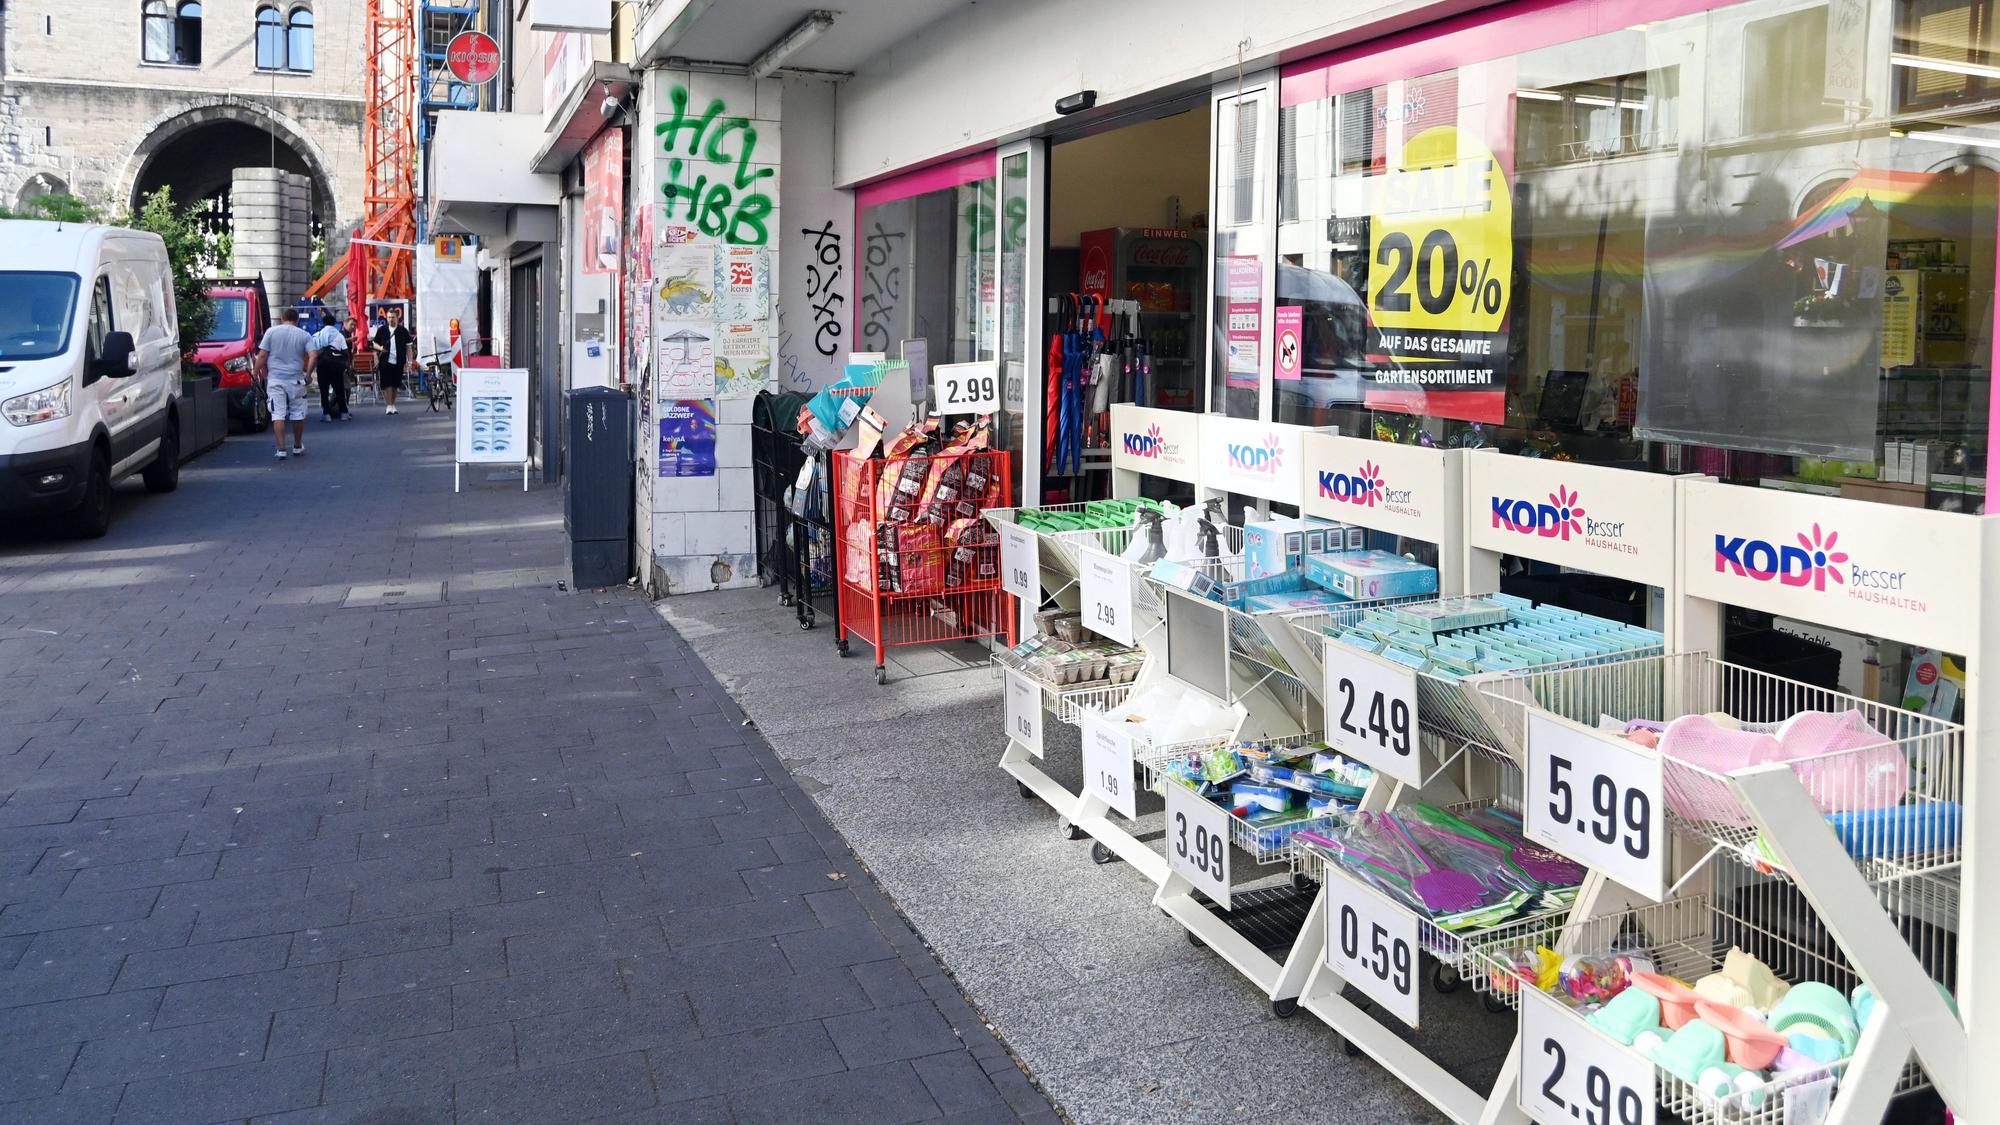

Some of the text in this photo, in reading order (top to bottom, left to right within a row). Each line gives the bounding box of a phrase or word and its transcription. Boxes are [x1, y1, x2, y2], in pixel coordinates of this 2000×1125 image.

[450, 51, 498, 63] KIOSK
[1143, 229, 1188, 239] EINWEG
[1375, 229, 1502, 315] 20%
[1379, 335, 1491, 355] AUF DAS GESAMTE
[946, 377, 994, 403] 2.99
[1375, 369, 1493, 385] GARTENSORTIMENT
[1124, 433, 1158, 459] KODi
[1228, 443, 1276, 474] KODi
[1319, 470, 1412, 508] KODi Besser
[1384, 504, 1422, 519] HAUSHALTEN
[1491, 496, 1625, 542] KODi Besser
[1585, 537, 1639, 556] HAUSHALTEN
[1715, 533, 1907, 592] KODi Besser
[1013, 568, 1028, 589] 0.99
[1848, 587, 1928, 614] HAUSHALTEN
[1097, 602, 1115, 626] 2.99
[1017, 715, 1032, 738] 0.99
[1339, 677, 1411, 757] 2.49
[1100, 770, 1118, 796] 1.99
[1549, 754, 1650, 860] 5.99
[1175, 811, 1224, 883] 3.99
[1341, 904, 1411, 996] 0.59
[1542, 1037, 1643, 1125] 2.99
